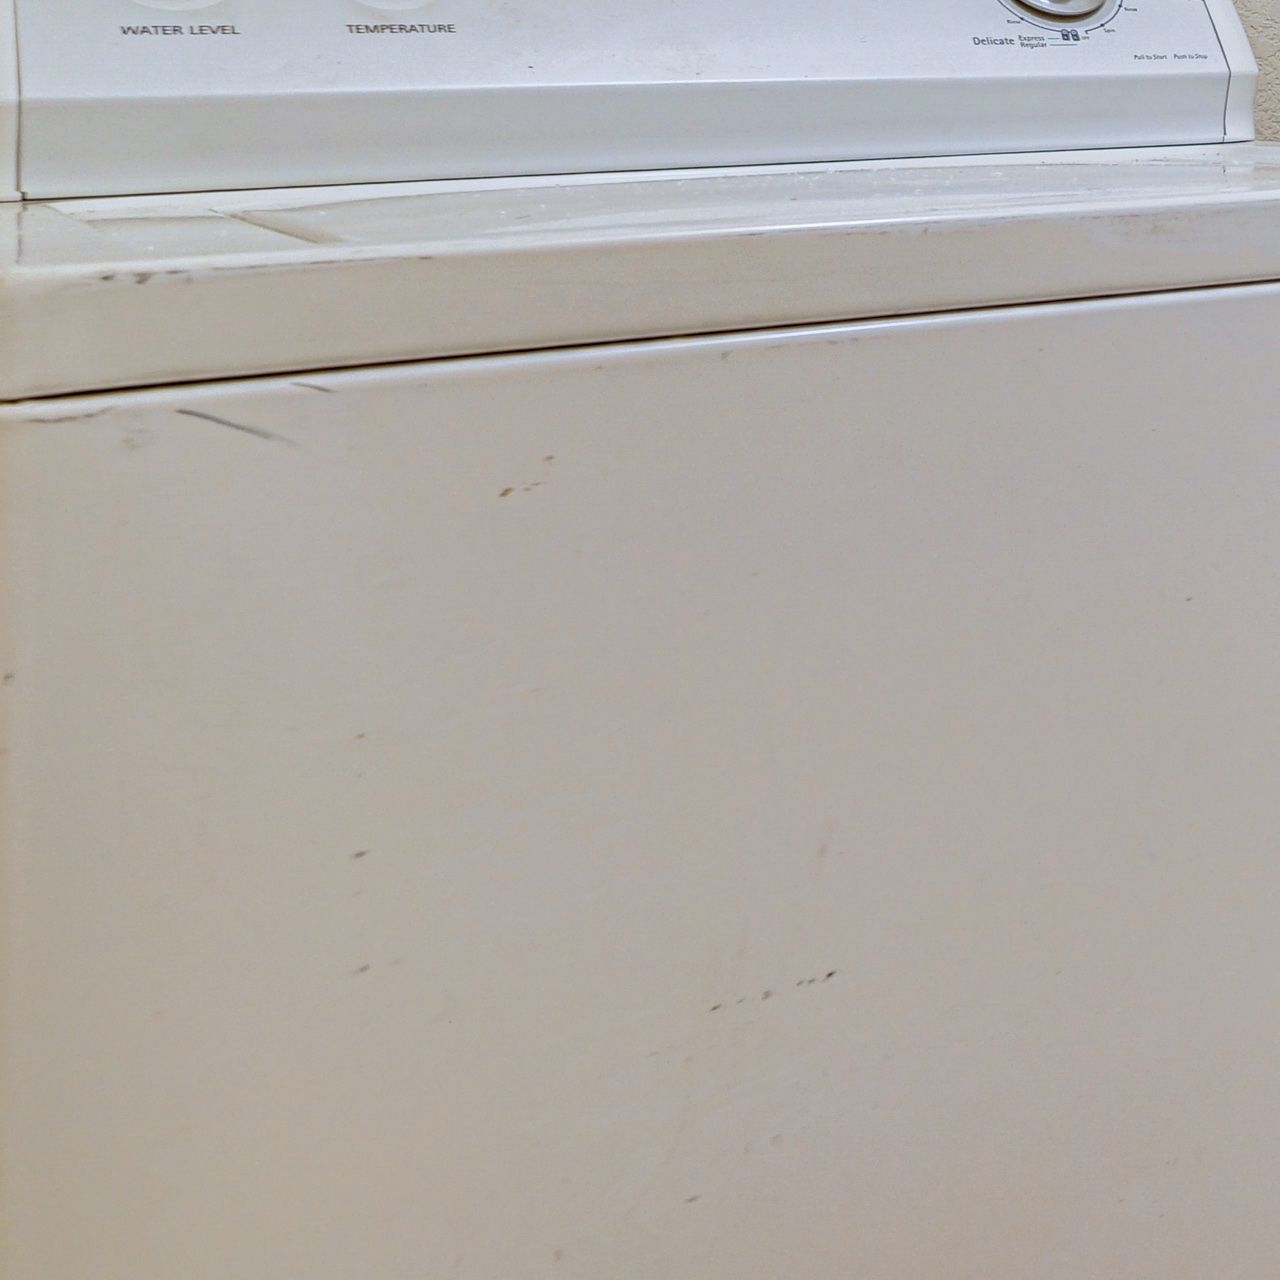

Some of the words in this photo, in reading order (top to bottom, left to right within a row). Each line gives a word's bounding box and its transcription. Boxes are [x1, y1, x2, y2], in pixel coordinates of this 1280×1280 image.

[121, 25, 182, 35] WATER
[190, 25, 240, 35] LEVEL
[346, 24, 456, 34] TEMPERATURE
[972, 36, 1015, 46] Delicate
[1018, 34, 1045, 42] Express
[1020, 41, 1047, 49] Regular
